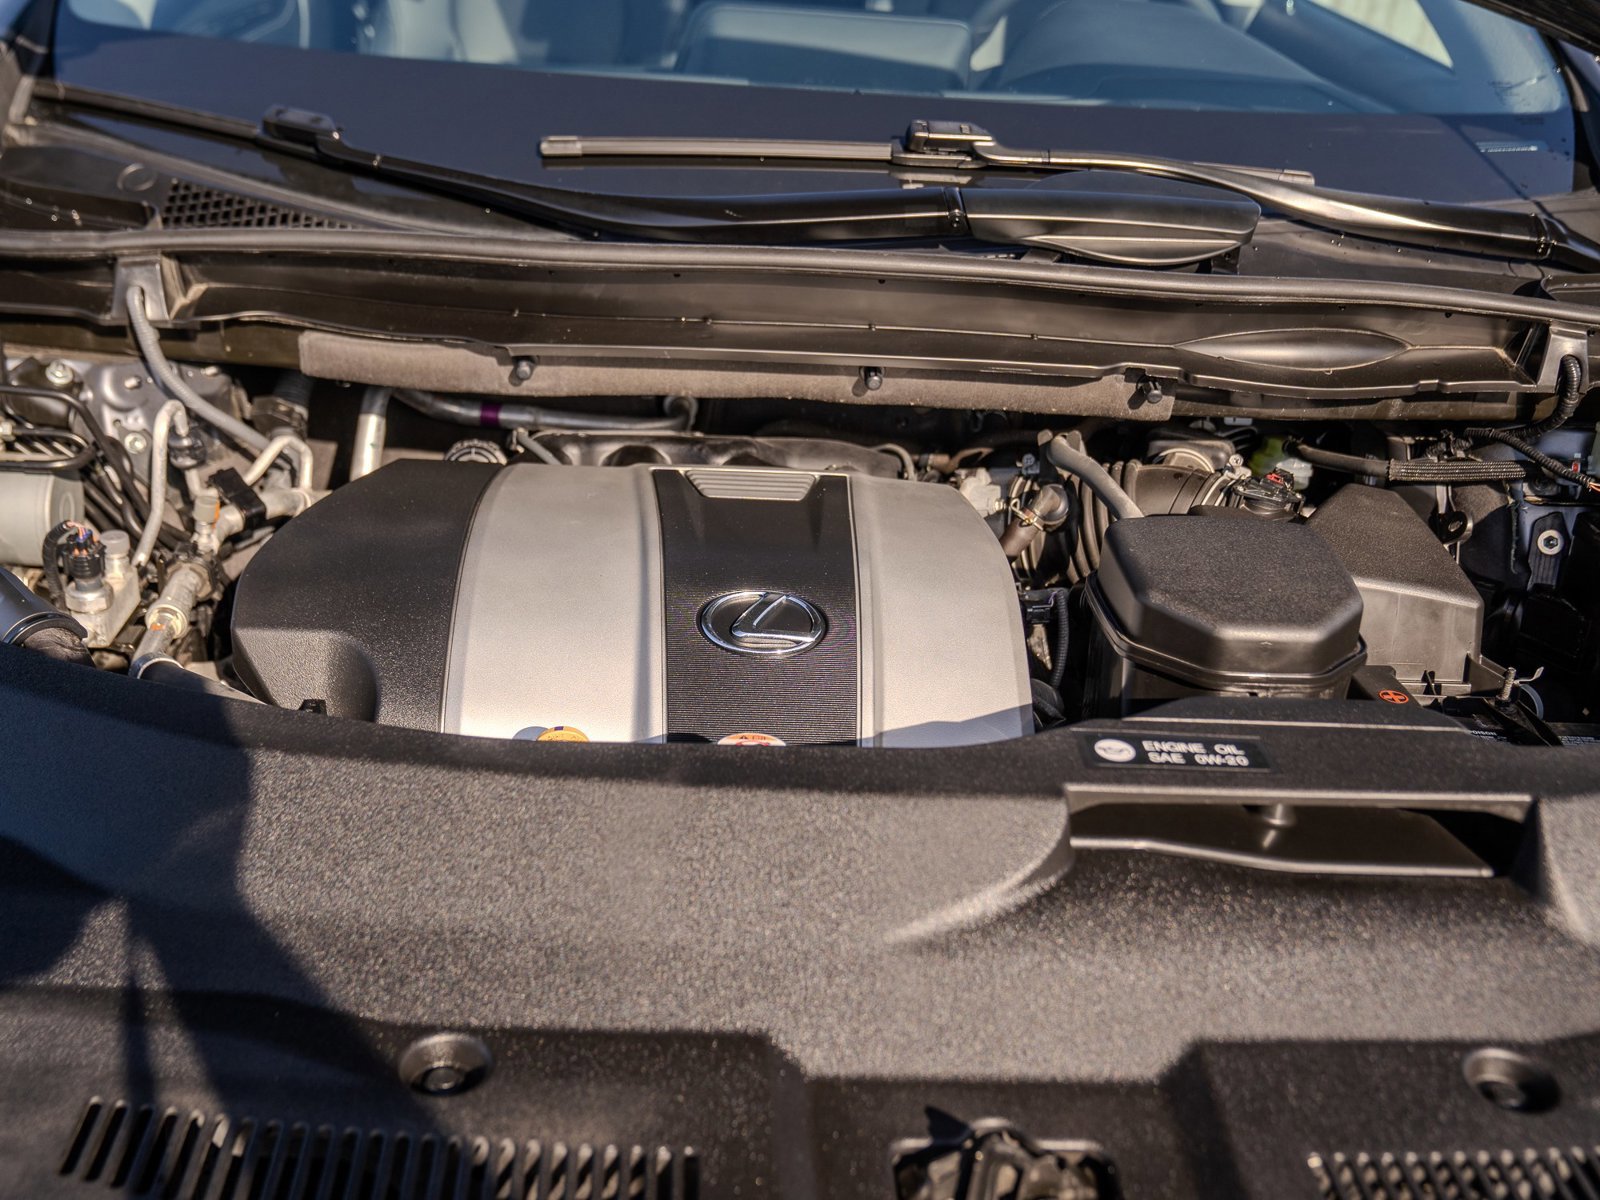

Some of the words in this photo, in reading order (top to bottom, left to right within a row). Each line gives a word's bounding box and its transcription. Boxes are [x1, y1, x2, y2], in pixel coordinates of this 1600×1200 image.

[1142, 740, 1206, 754] ENGINE
[1214, 743, 1245, 756] OIL
[1147, 752, 1186, 765] SAE
